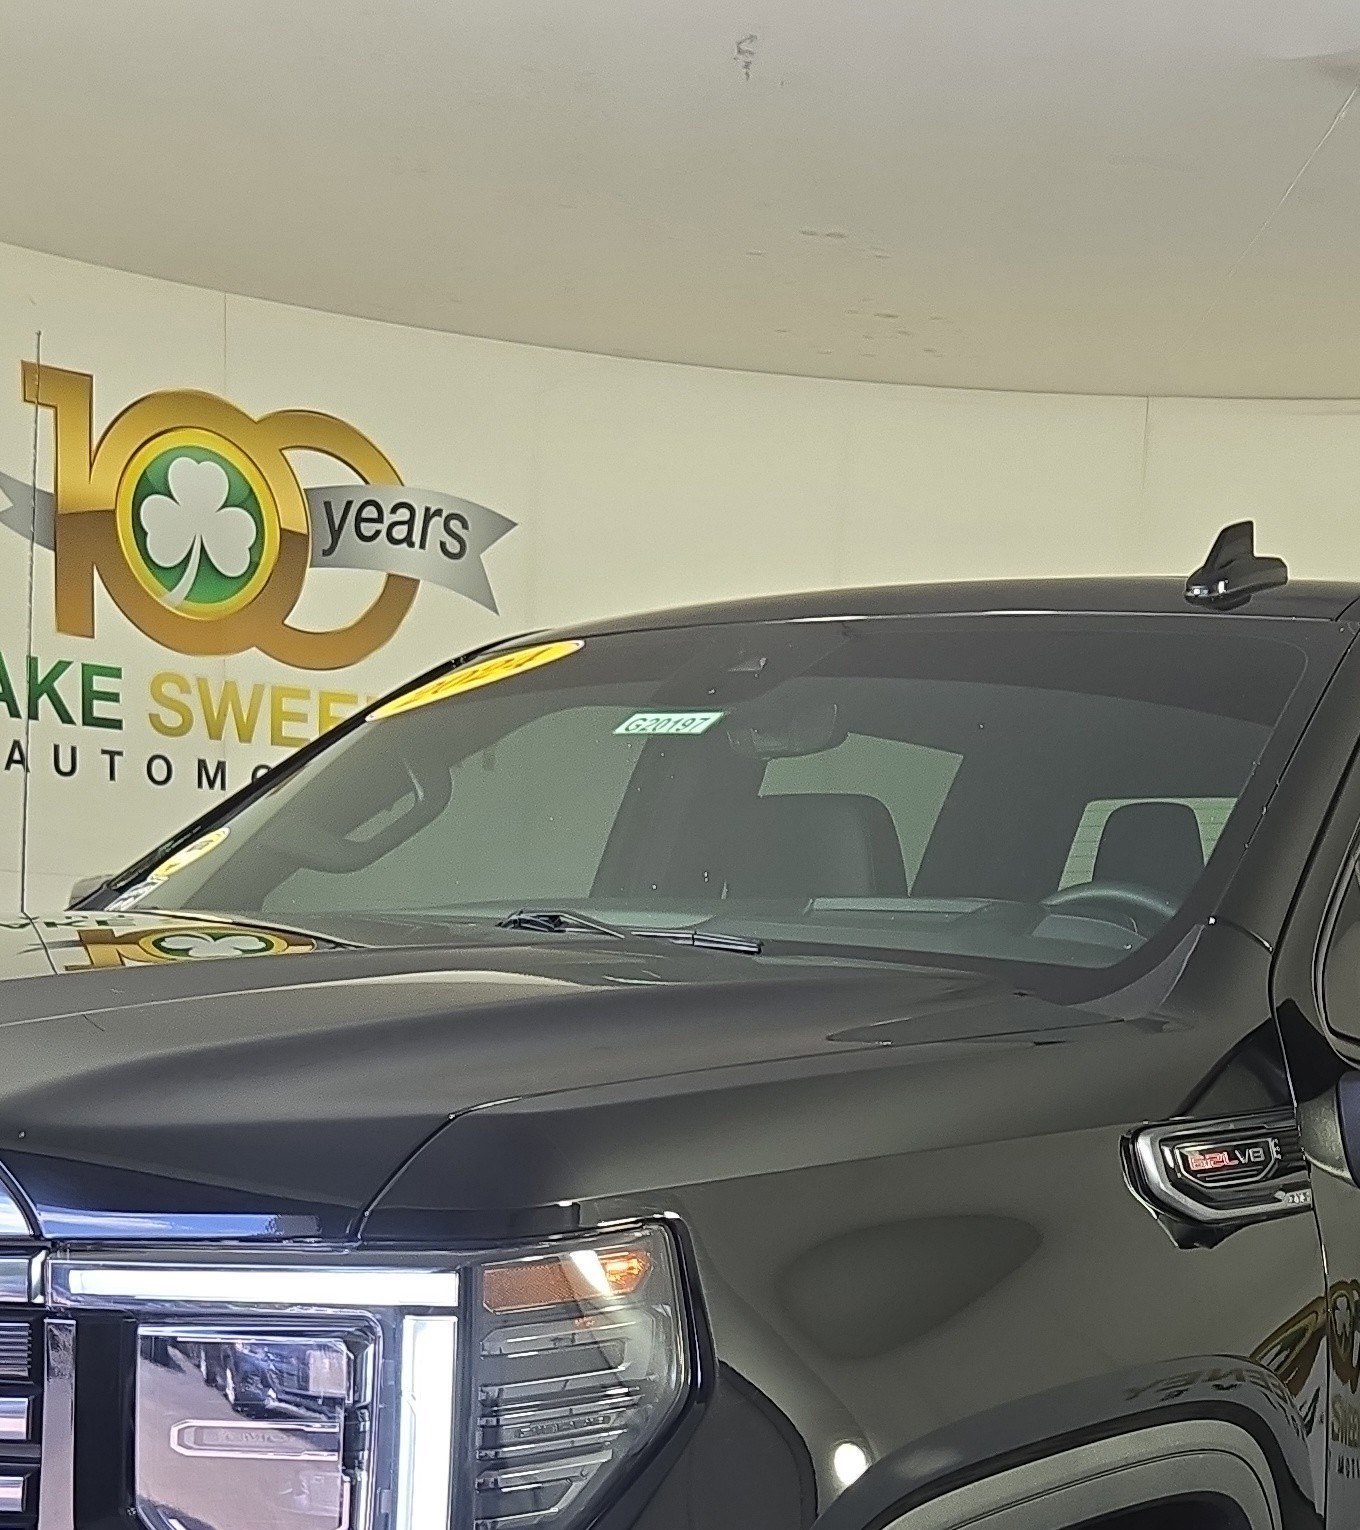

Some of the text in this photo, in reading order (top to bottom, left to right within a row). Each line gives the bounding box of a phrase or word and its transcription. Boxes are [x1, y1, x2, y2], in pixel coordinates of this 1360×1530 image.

[20, 360, 470, 671] 100 years
[147, 671, 380, 748] SWEE
[624, 717, 712, 733] G20197
